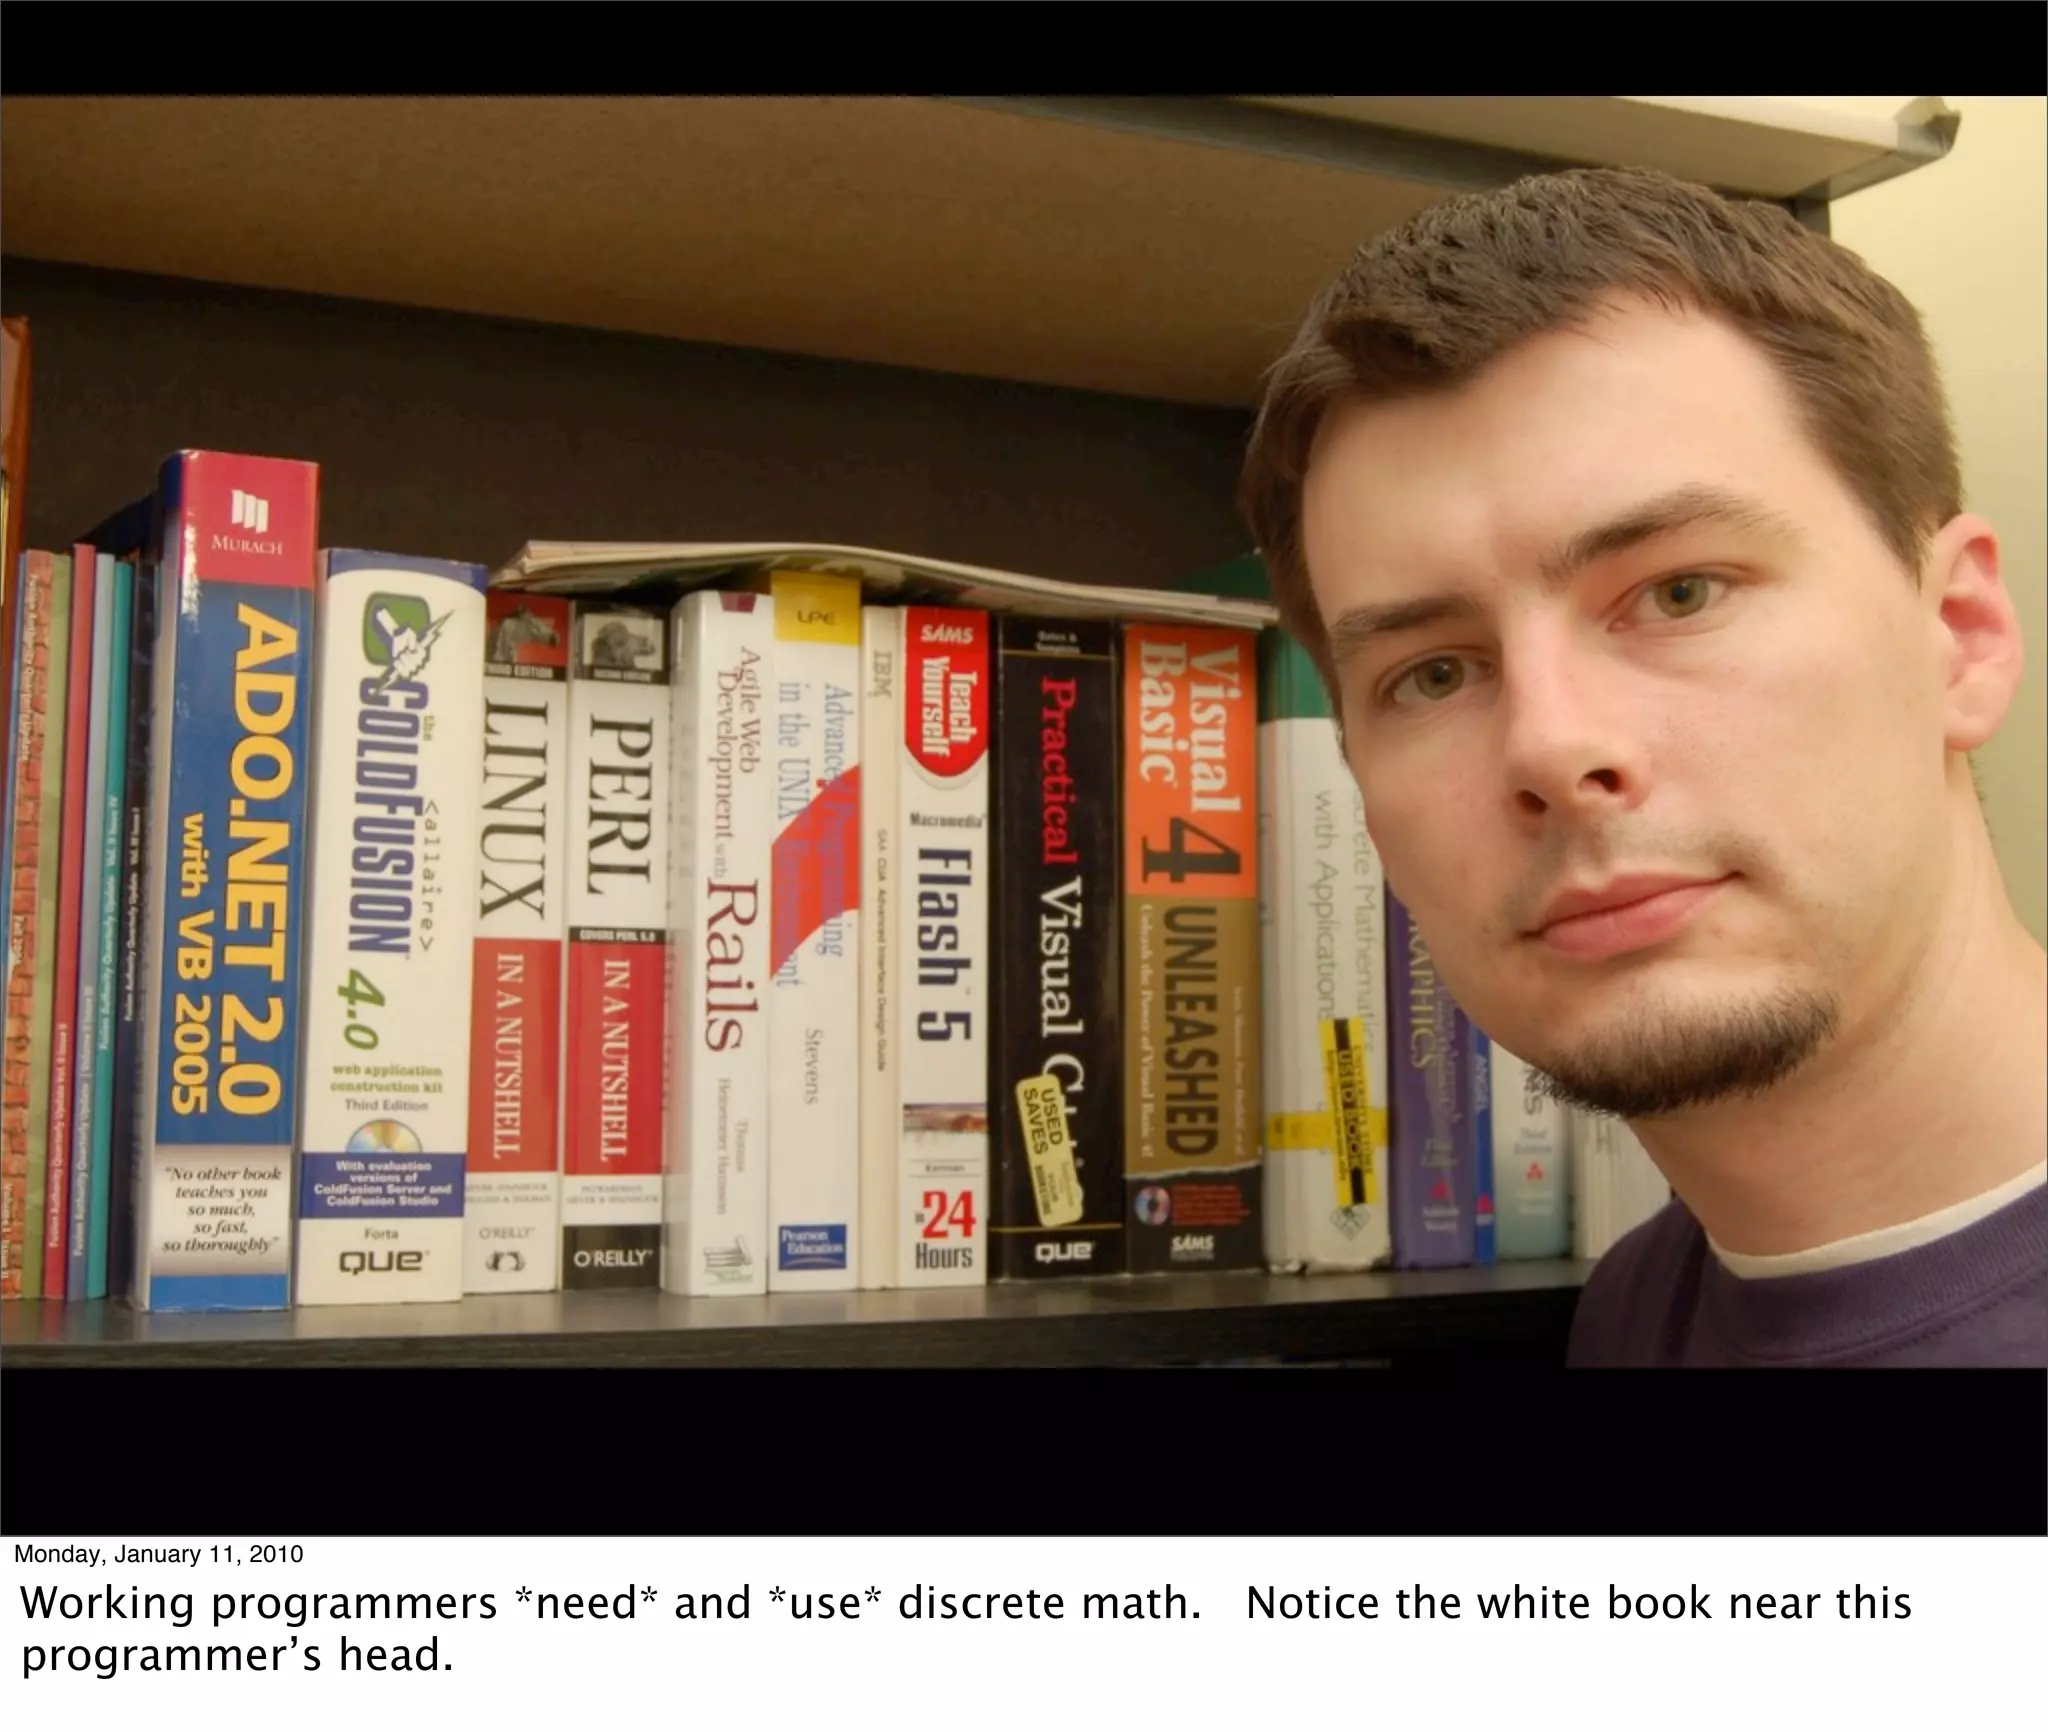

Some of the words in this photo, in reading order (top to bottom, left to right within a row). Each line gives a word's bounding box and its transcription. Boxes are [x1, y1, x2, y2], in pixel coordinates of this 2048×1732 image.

[920, 623, 975, 645] SAMS
[733, 646, 762, 715] Agile
[778, 681, 810, 703] in
[871, 650, 893, 699] IBM
[421, 713, 437, 742] the
[778, 712, 808, 748] the
[921, 655, 952, 759] Yourself
[949, 671, 979, 744] Teach
[1140, 640, 1191, 783] Basic
[1189, 644, 1243, 813] Visual
[707, 670, 740, 840] Development
[739, 718, 761, 774] Web
[823, 683, 854, 794] Advanced
[223, 603, 299, 983] ADO.NET
[777, 757, 811, 823] UNIX
[1041, 676, 1080, 865] Practical
[480, 696, 549, 921] LINUX
[587, 712, 654, 895] PERL
[909, 812, 984, 829] Macromedia
[1314, 789, 1340, 850] with
[182, 813, 209, 899] with
[713, 843, 728, 879] with
[1141, 816, 1243, 884] 4
[876, 888, 888, 944] Advanced
[917, 847, 972, 986] Flash
[177, 909, 216, 981] VB
[496, 952, 524, 984] IN
[704, 877, 759, 1053] Rails
[876, 944, 888, 995] Interface
[1041, 875, 1085, 1039] Visual
[496, 989, 523, 1010] A
[603, 959, 631, 990] IN
[338, 968, 386, 1051] 4.0
[603, 995, 630, 1016] A
[876, 997, 888, 1037] Design
[917, 1010, 972, 1042] 5
[1140, 989, 1155, 1032] Power
[171, 993, 212, 1116] 2005
[217, 993, 285, 1116] 2.0
[876, 1038, 888, 1072] Guide
[1164, 906, 1220, 1157] UNLEASHED
[330, 1081, 419, 1094] construction
[423, 1081, 444, 1094] kit
[333, 1065, 361, 1081] web
[364, 1064, 443, 1085] application
[493, 1016, 522, 1160] NUTSHELL
[600, 1020, 629, 1162] NUTSHELL
[803, 1027, 825, 1106] Stevens
[1140, 1054, 1155, 1098] Visual
[1338, 1049, 1359, 1103] USED
[345, 1099, 379, 1112] Third
[382, 1100, 429, 1112] Edition
[1023, 1087, 1049, 1156] SAVES
[1041, 1087, 1064, 1146] USED
[1344, 1108, 1365, 1171] BOOK
[197, 1166, 241, 1181] other
[243, 1166, 282, 1181] book
[314, 1183, 383, 1195] ColdFusion
[386, 1184, 426, 1195] Server
[429, 1183, 453, 1195] and
[335, 1160, 365, 1172] With
[368, 1160, 433, 1172] evaluation
[349, 1173, 400, 1183] versions
[405, 1172, 418, 1183] of
[175, 1186, 235, 1199] teaches
[239, 1188, 268, 1202] you
[188, 1205, 206, 1217] so
[209, 1203, 256, 1217] much,
[326, 1195, 395, 1207] ColdFusion
[399, 1195, 440, 1207] Studio
[921, 1189, 978, 1240] 24
[161, 1240, 181, 1253] so
[193, 1223, 212, 1235] so
[365, 1227, 399, 1240] Forta
[781, 1228, 828, 1242] Pearson
[787, 1242, 845, 1255] Education
[1170, 1233, 1215, 1251] SAMS
[574, 1249, 648, 1268] O'REILLY
[915, 1242, 974, 1270] Hours
